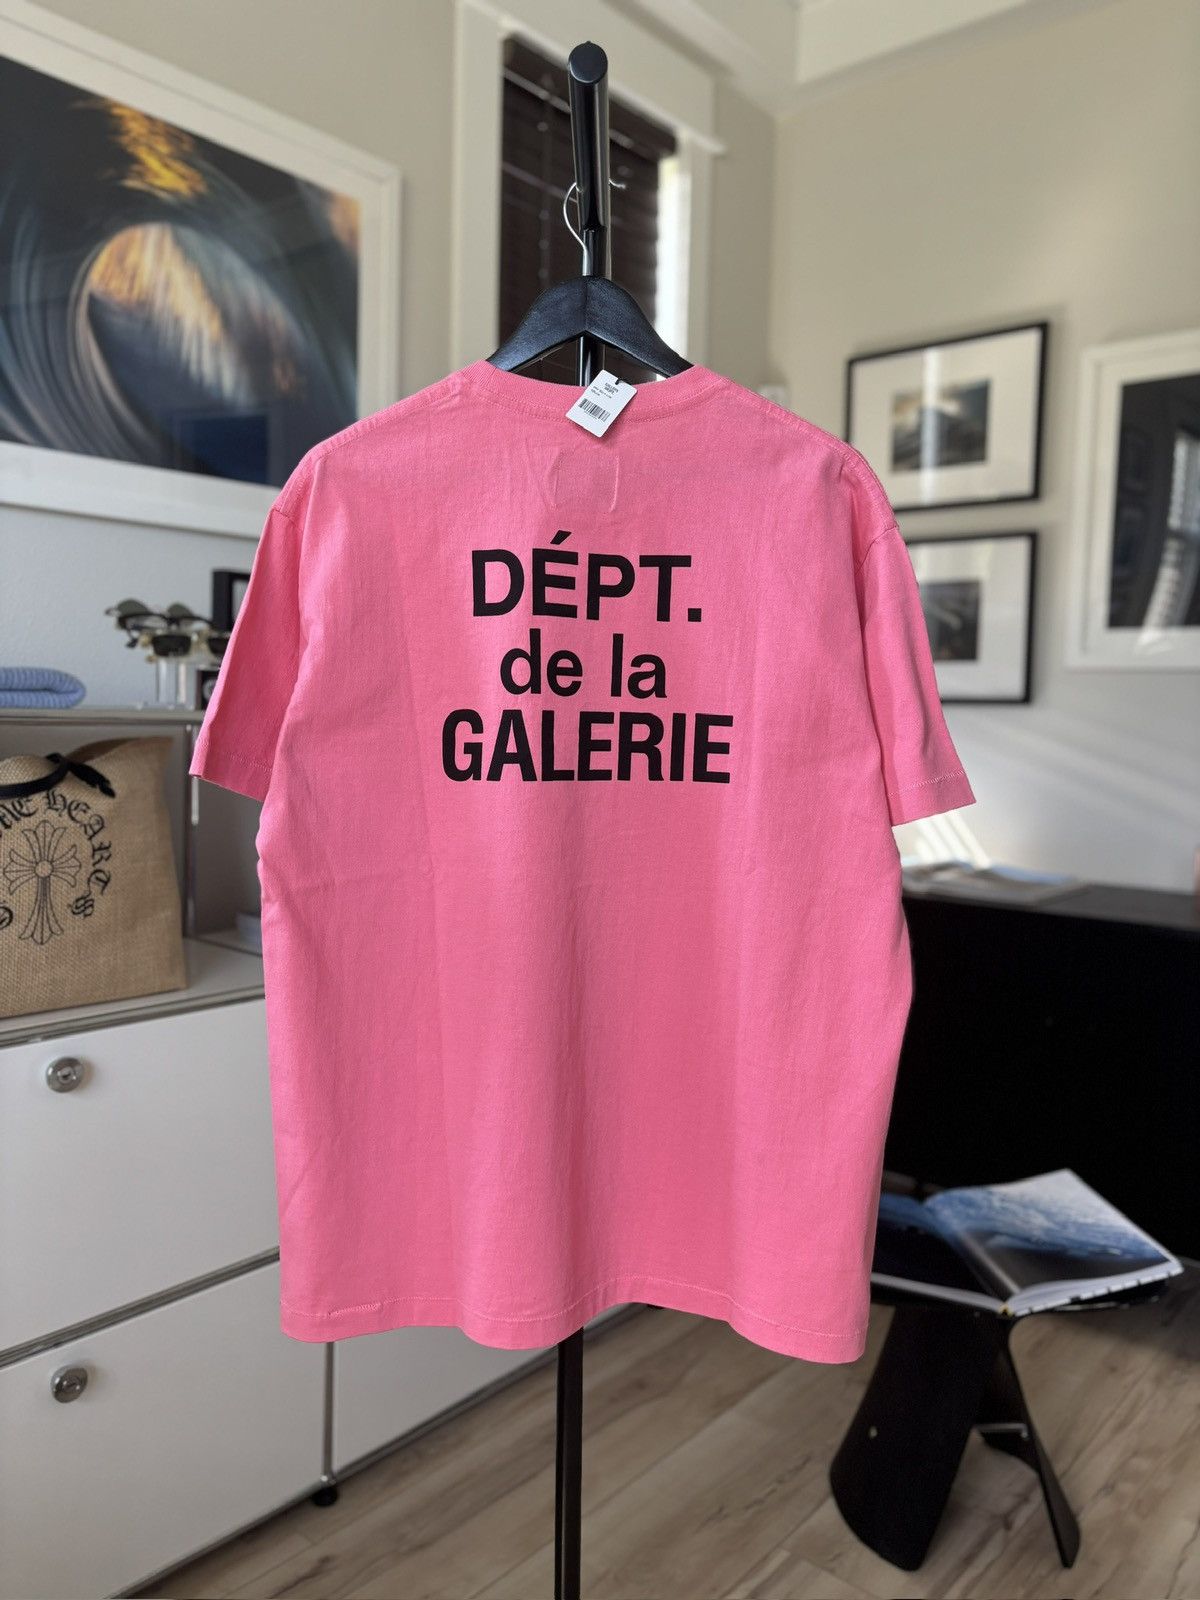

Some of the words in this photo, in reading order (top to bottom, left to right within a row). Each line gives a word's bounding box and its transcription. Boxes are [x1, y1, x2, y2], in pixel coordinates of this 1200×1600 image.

[471, 529, 702, 623] DÉPT.
[500, 628, 583, 697] de
[610, 633, 668, 699] la
[442, 708, 734, 784] GALERIE
[44, 789, 112, 919] HEARTS
